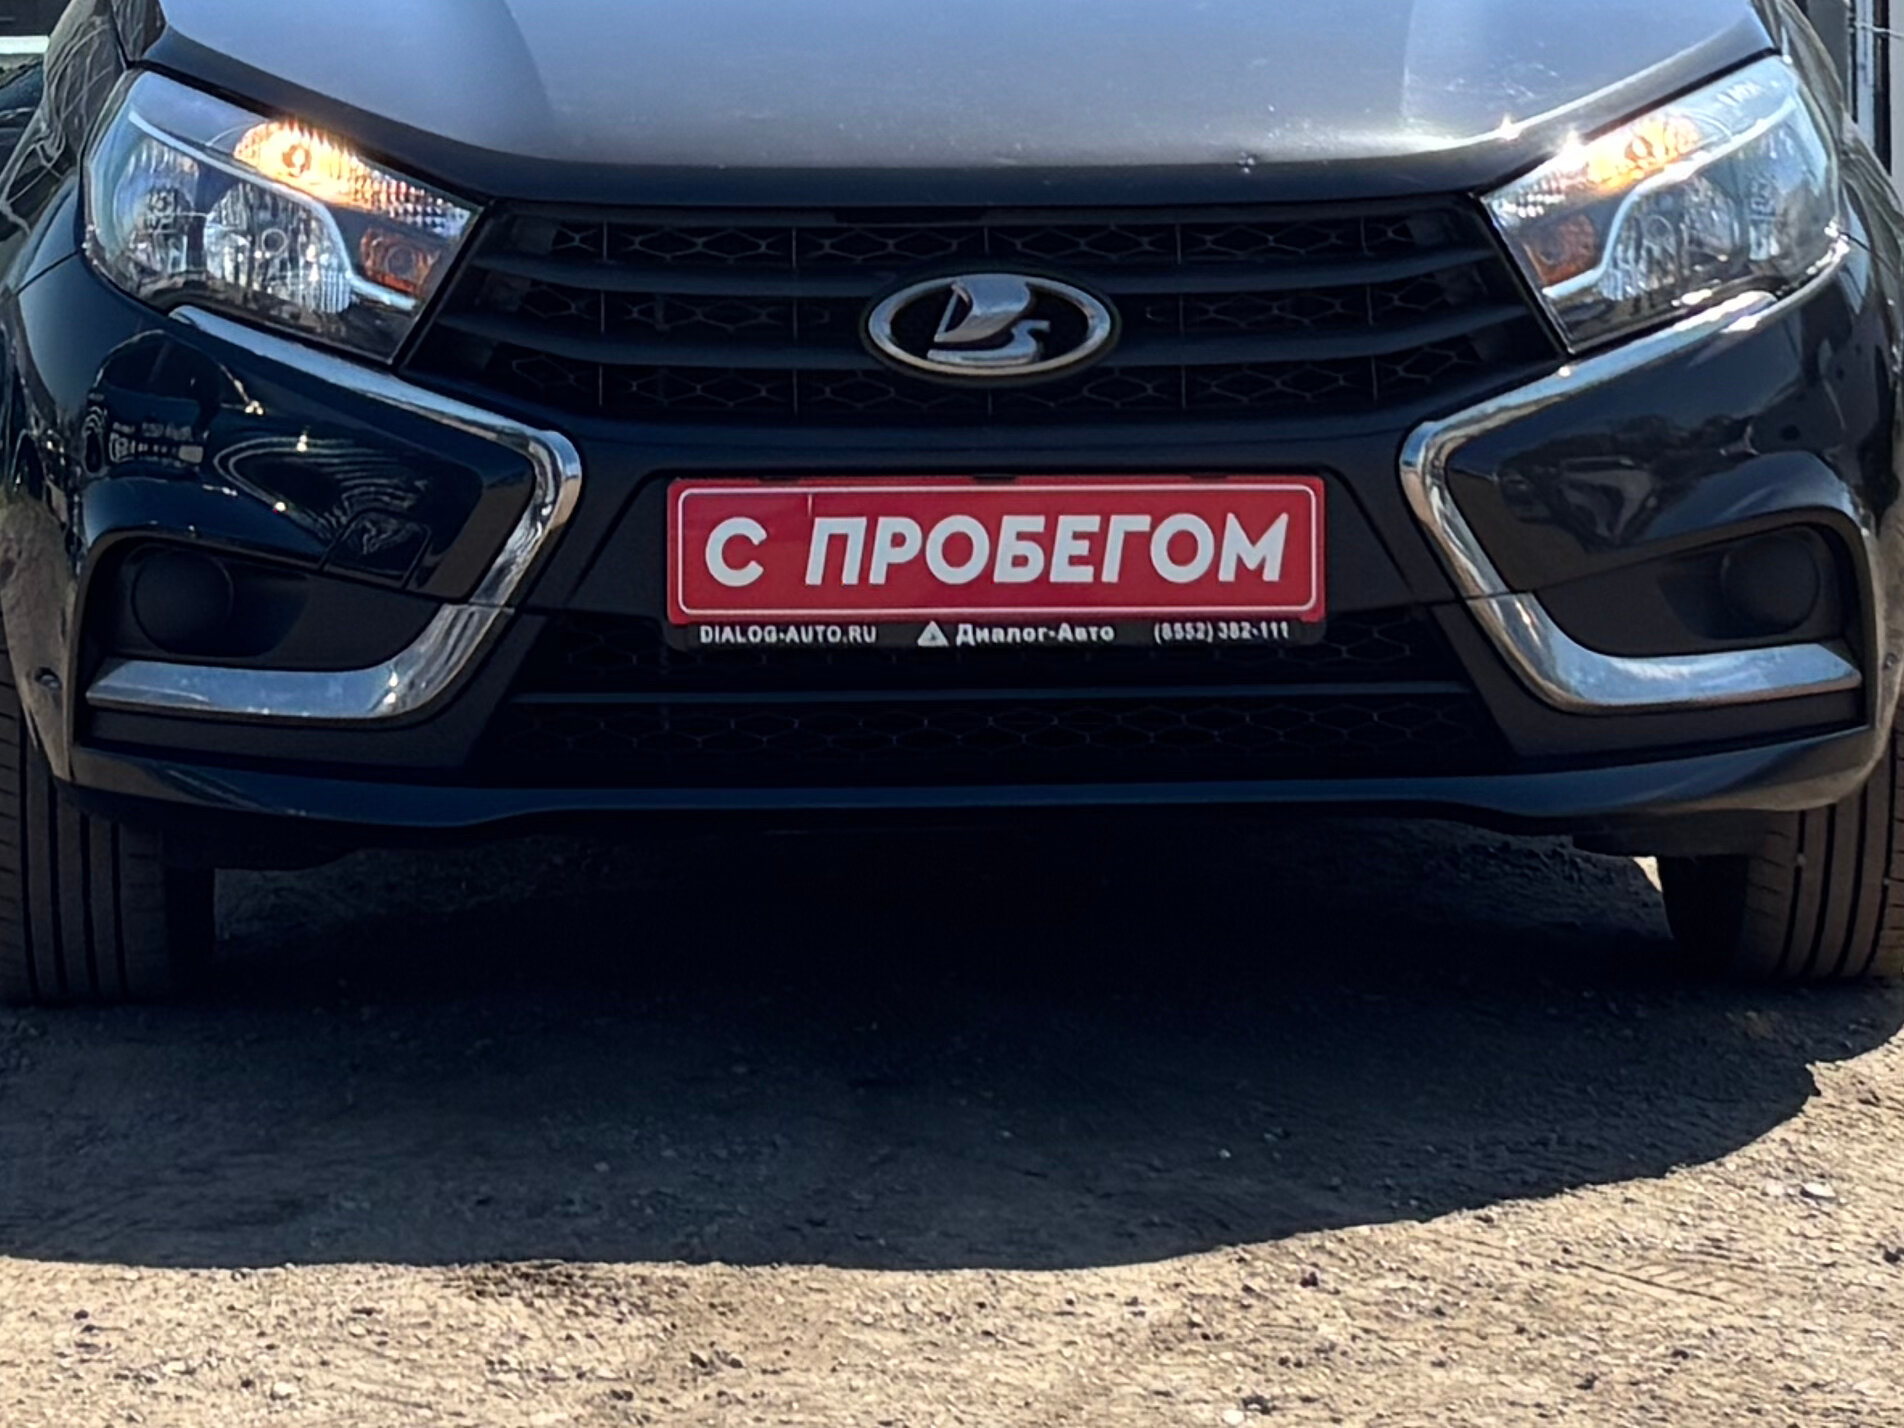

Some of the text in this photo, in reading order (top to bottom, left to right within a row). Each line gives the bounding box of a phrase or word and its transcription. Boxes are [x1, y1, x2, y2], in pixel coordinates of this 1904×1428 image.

[704, 512, 1289, 587] С ПРОБЕГОМ
[699, 624, 878, 644] DIALOG-AUTO.RU
[955, 622, 1116, 646] Диалог-Авто
[1153, 620, 1290, 644] (8552) 382-111
